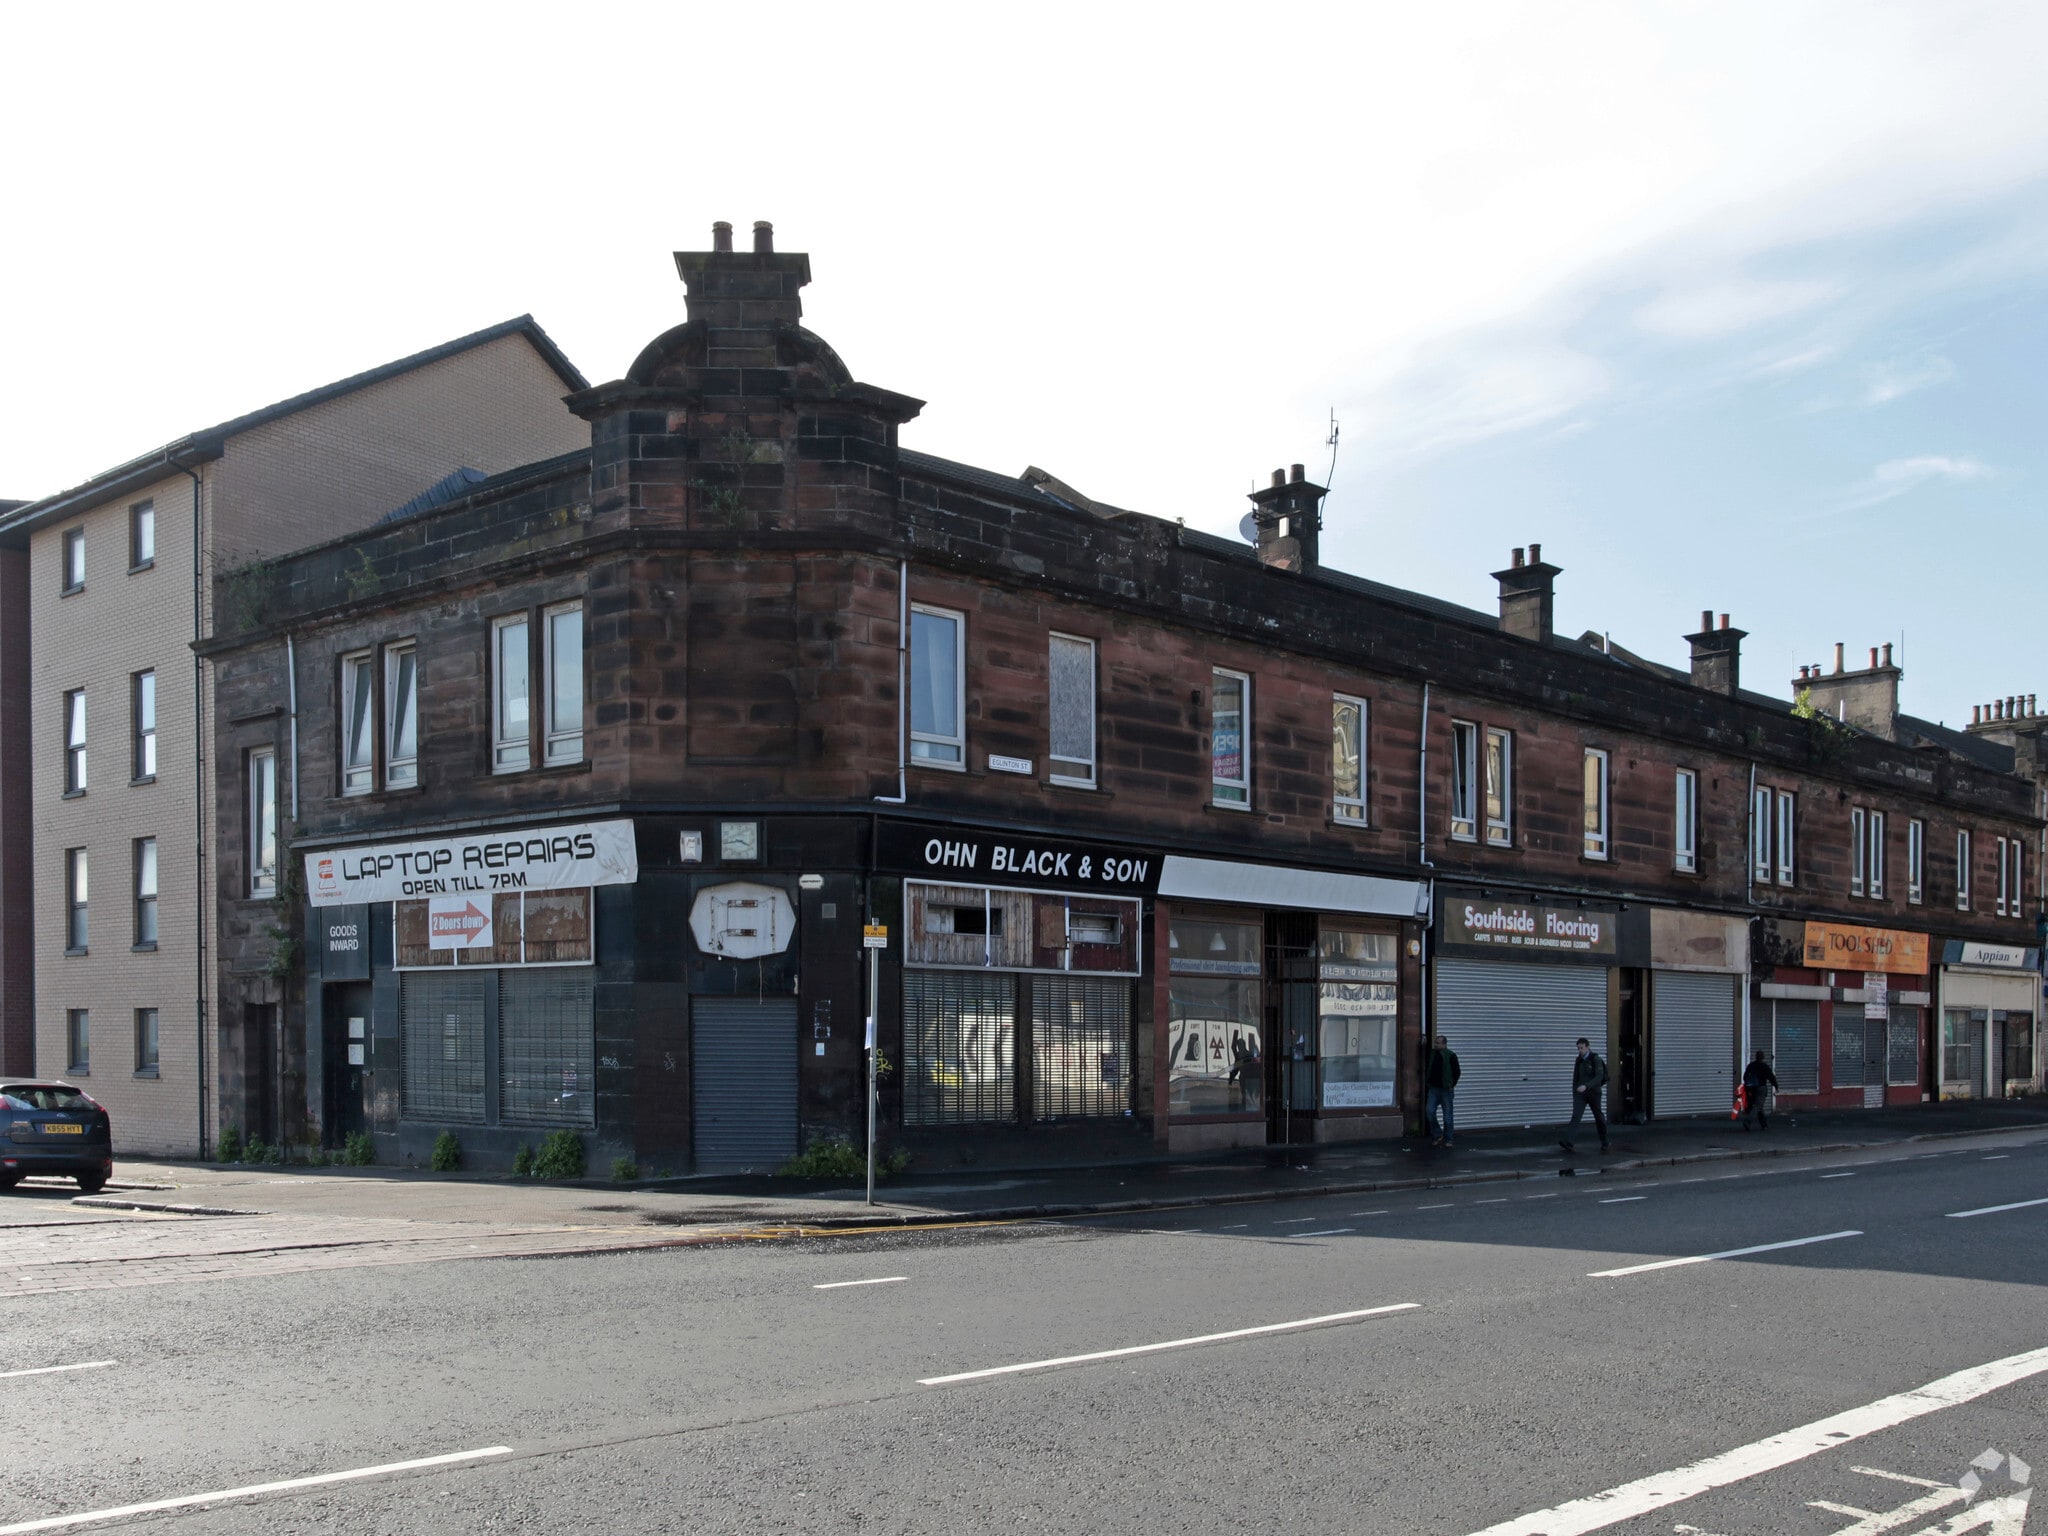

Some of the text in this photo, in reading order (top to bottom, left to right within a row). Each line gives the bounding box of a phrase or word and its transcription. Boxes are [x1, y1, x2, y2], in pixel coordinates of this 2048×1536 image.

[992, 758, 1020, 769] EGLINTON
[343, 834, 596, 880] LAPTOP REPAIRS
[924, 839, 1148, 882] OHN BLACK & SON
[402, 872, 528, 895] OPEN TILL 7PM
[433, 914, 484, 930] 2 Doors down
[1464, 905, 1599, 942] Southside Flooring
[329, 924, 357, 937] GOODS
[1474, 933, 1491, 942] CARPETS
[330, 939, 359, 952] INWARD
[1828, 932, 1862, 953] TOOL
[1974, 949, 2010, 963] Appian
